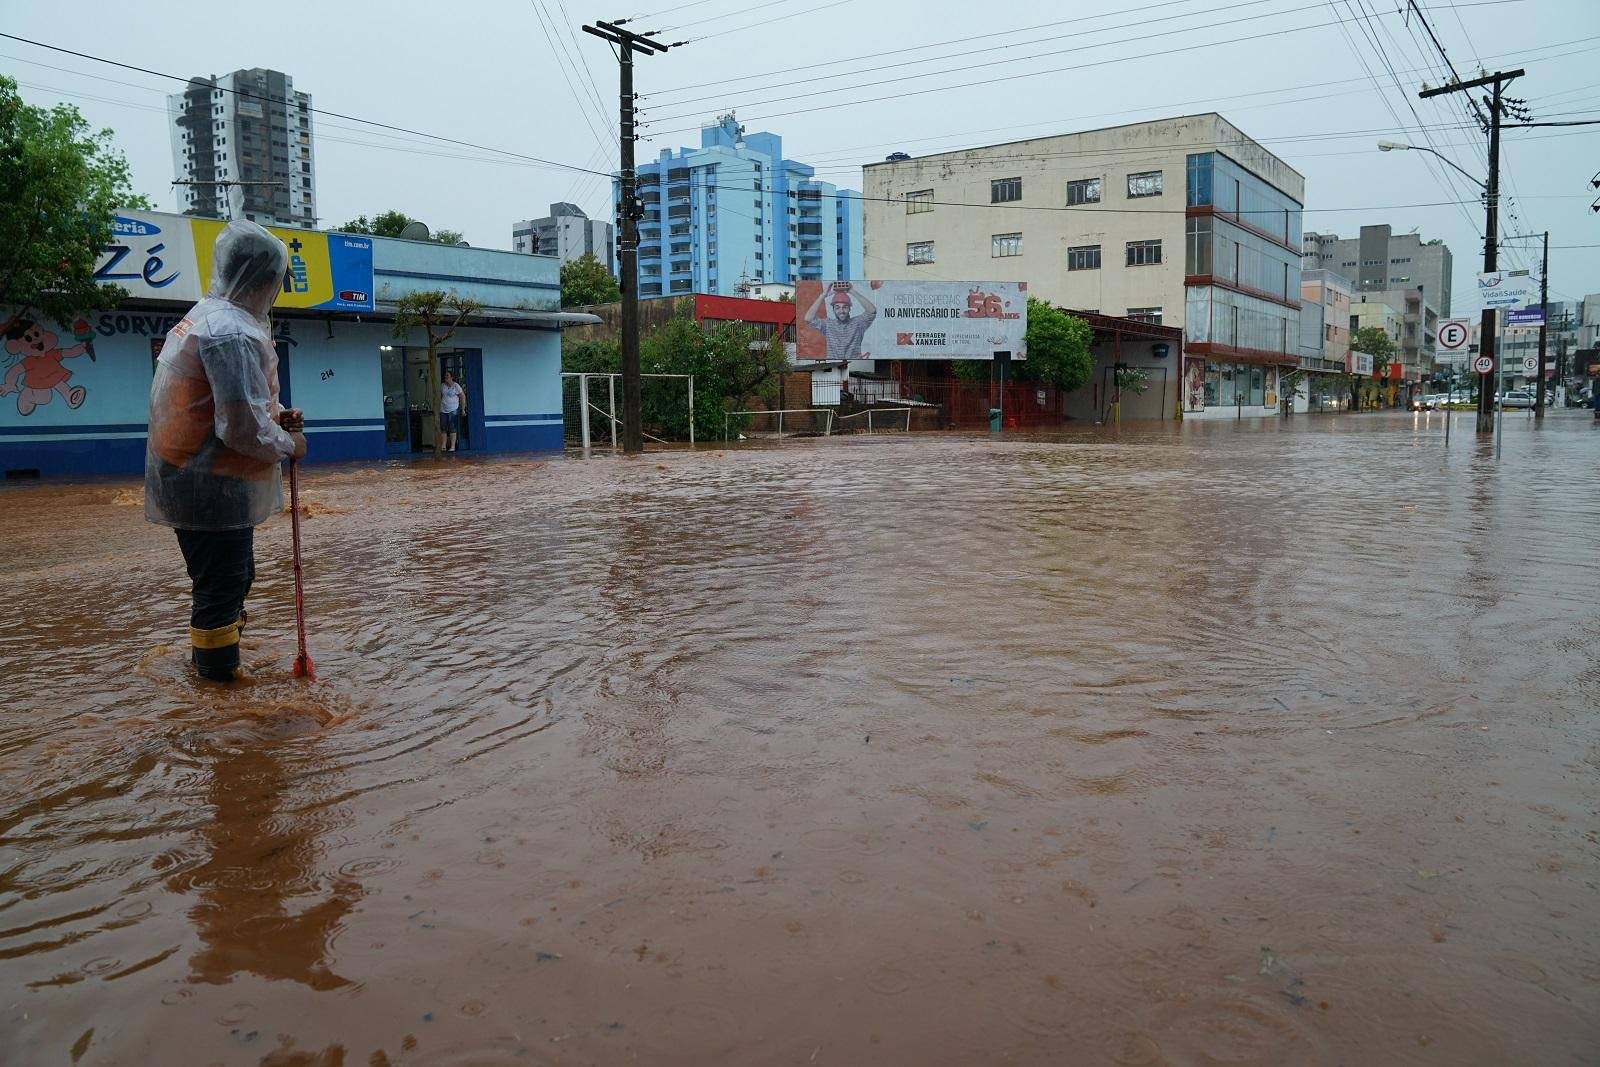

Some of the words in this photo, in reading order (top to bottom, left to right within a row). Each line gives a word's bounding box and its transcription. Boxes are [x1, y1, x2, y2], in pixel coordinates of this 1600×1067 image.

[352, 292, 365, 301] TIM
[884, 307, 896, 318] NO
[897, 305, 949, 319] ANIVERSÁRIO
[950, 308, 961, 319] DE
[967, 292, 1003, 319] 56
[1447, 328, 1458, 342] E
[1478, 358, 1490, 367] 40
[320, 368, 335, 381] 214
